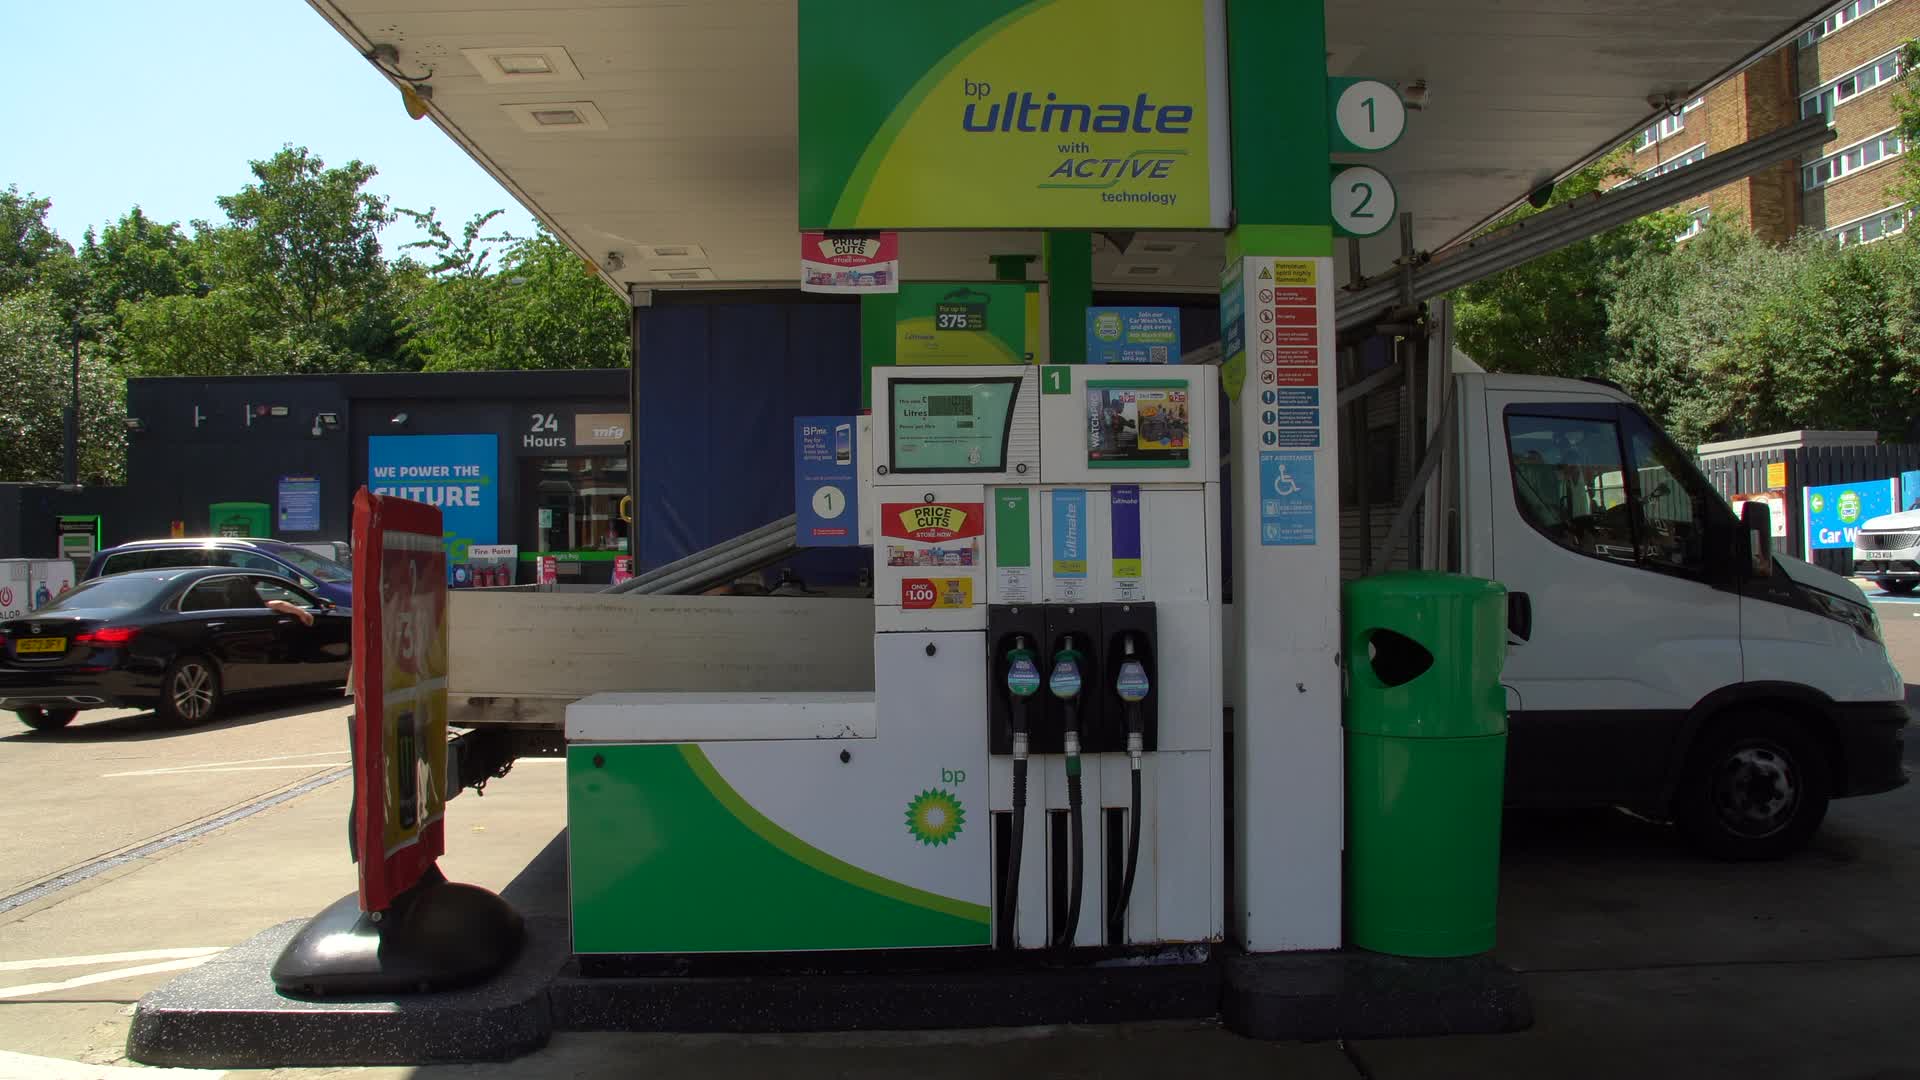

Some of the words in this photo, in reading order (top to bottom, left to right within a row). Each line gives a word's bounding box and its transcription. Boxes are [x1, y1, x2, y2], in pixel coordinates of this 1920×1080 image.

[964, 77, 991, 100] bp
[963, 92, 1193, 134] ultimate
[1360, 97, 1375, 132] 1
[1058, 141, 1090, 154] with
[1049, 158, 1175, 180] ACTIVE
[1102, 190, 1177, 206] technology
[1350, 182, 1375, 219] 2
[832, 238, 867, 247] PRICE
[835, 246, 864, 254] CUTS
[938, 314, 967, 329] 375
[1050, 371, 1061, 390] 1
[904, 408, 928, 417] Litres
[530, 413, 559, 433] 24
[523, 434, 567, 448] Hours
[374, 466, 396, 478] WE
[399, 466, 448, 478] POWER
[453, 465, 481, 477] THE
[823, 493, 832, 512] 1
[914, 507, 952, 519] PRICE
[917, 517, 949, 528] CUTS
[1819, 528, 1842, 544] Car
[474, 548, 489, 556] Fire
[491, 547, 511, 556] Point
[906, 590, 934, 601] £1.00
[942, 767, 966, 787] bp
